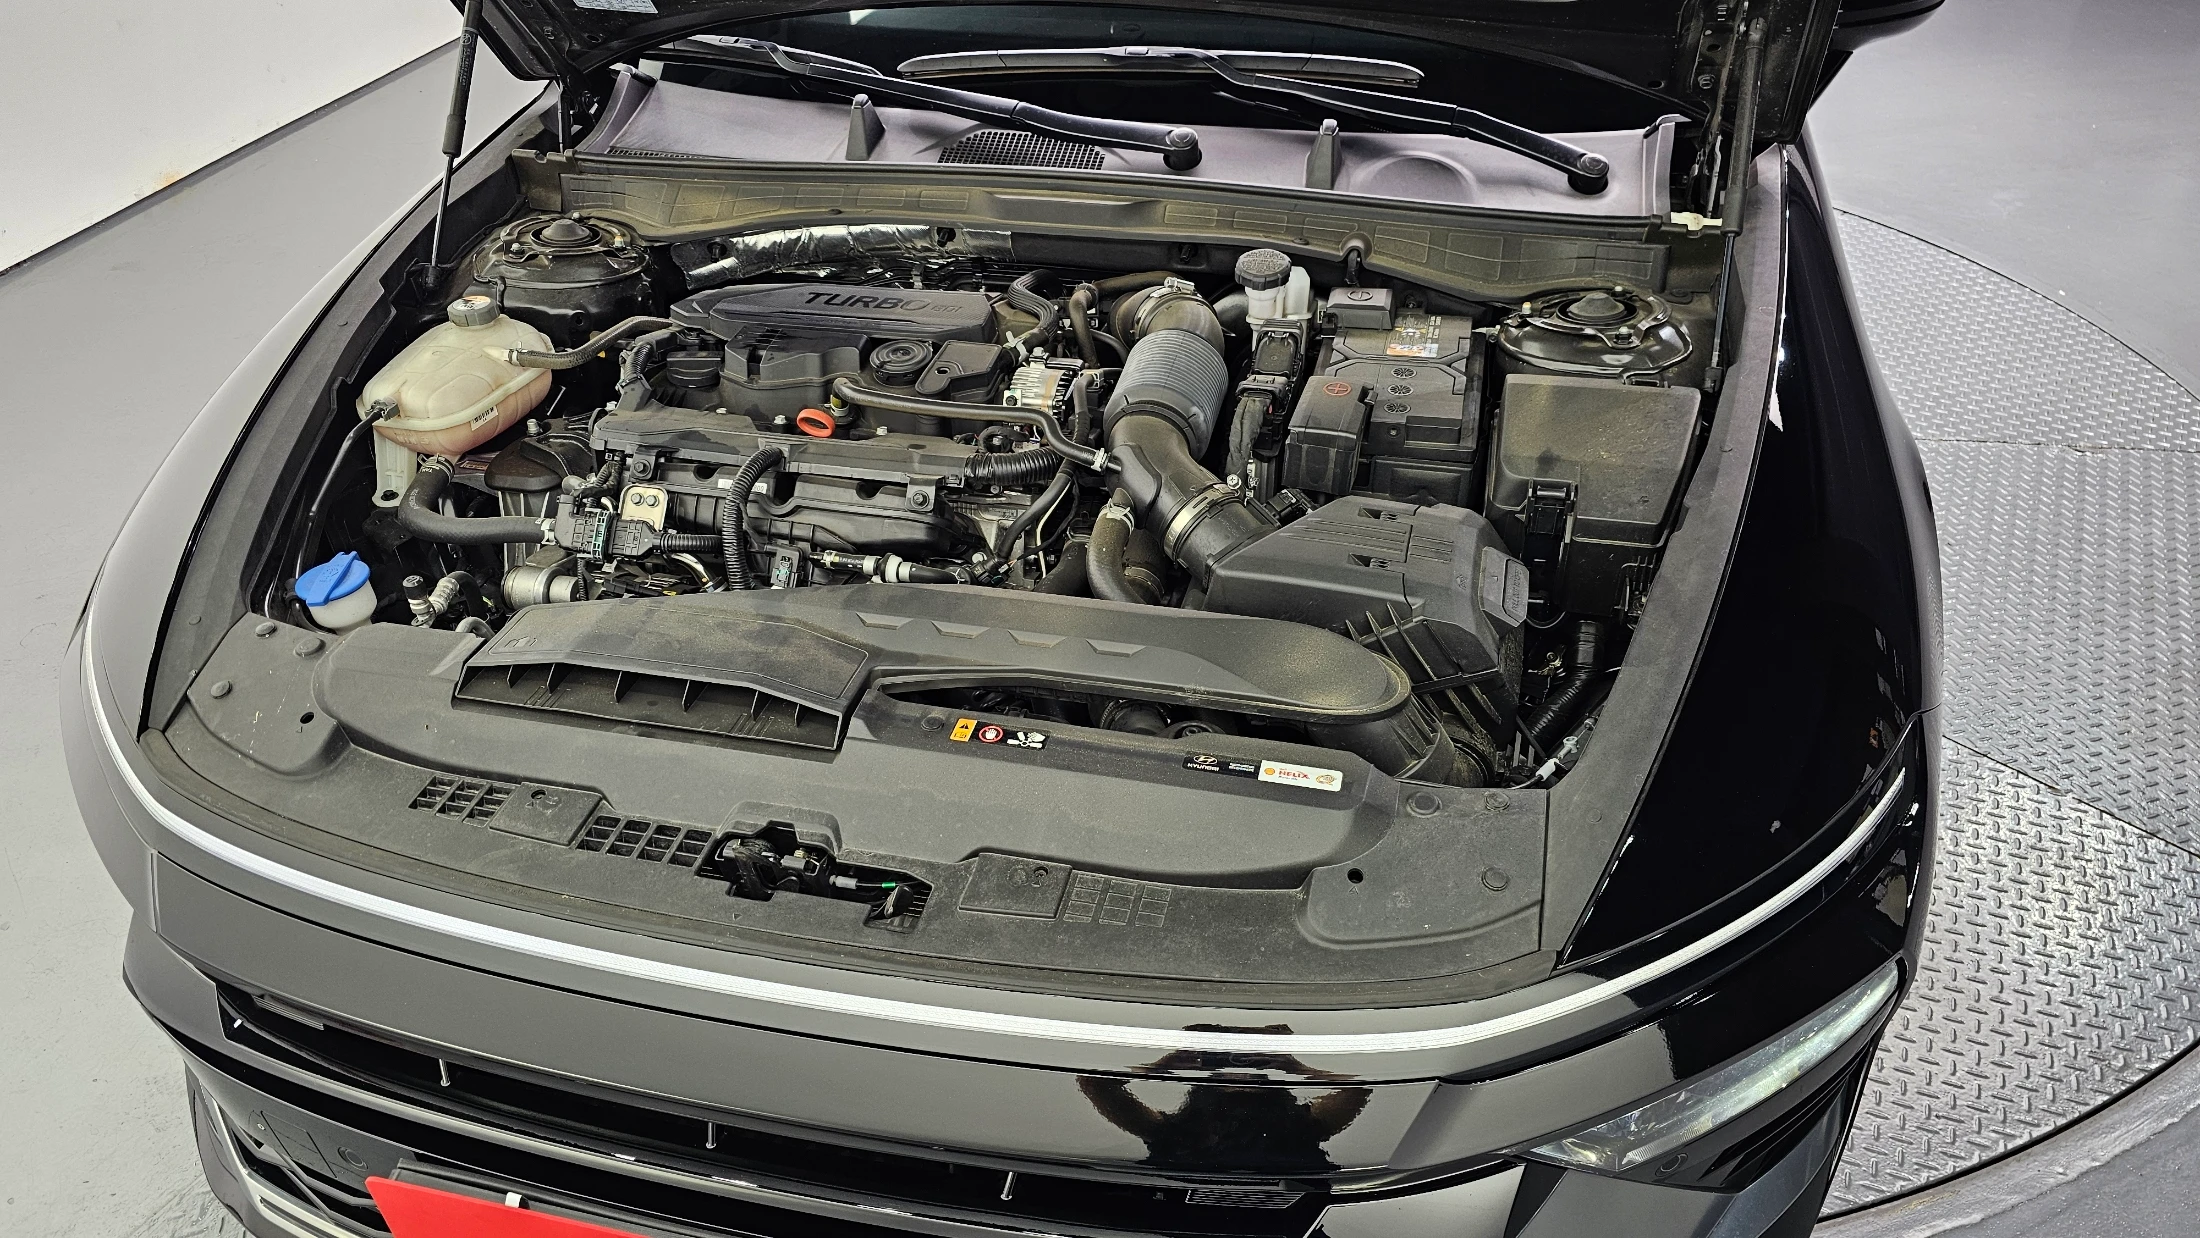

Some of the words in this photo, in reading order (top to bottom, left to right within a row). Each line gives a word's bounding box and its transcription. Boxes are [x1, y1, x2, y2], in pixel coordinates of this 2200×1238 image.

[805, 292, 931, 311] TURBO
[1187, 762, 1220, 772] HYUNDAI
[1278, 770, 1310, 779] HELIX
